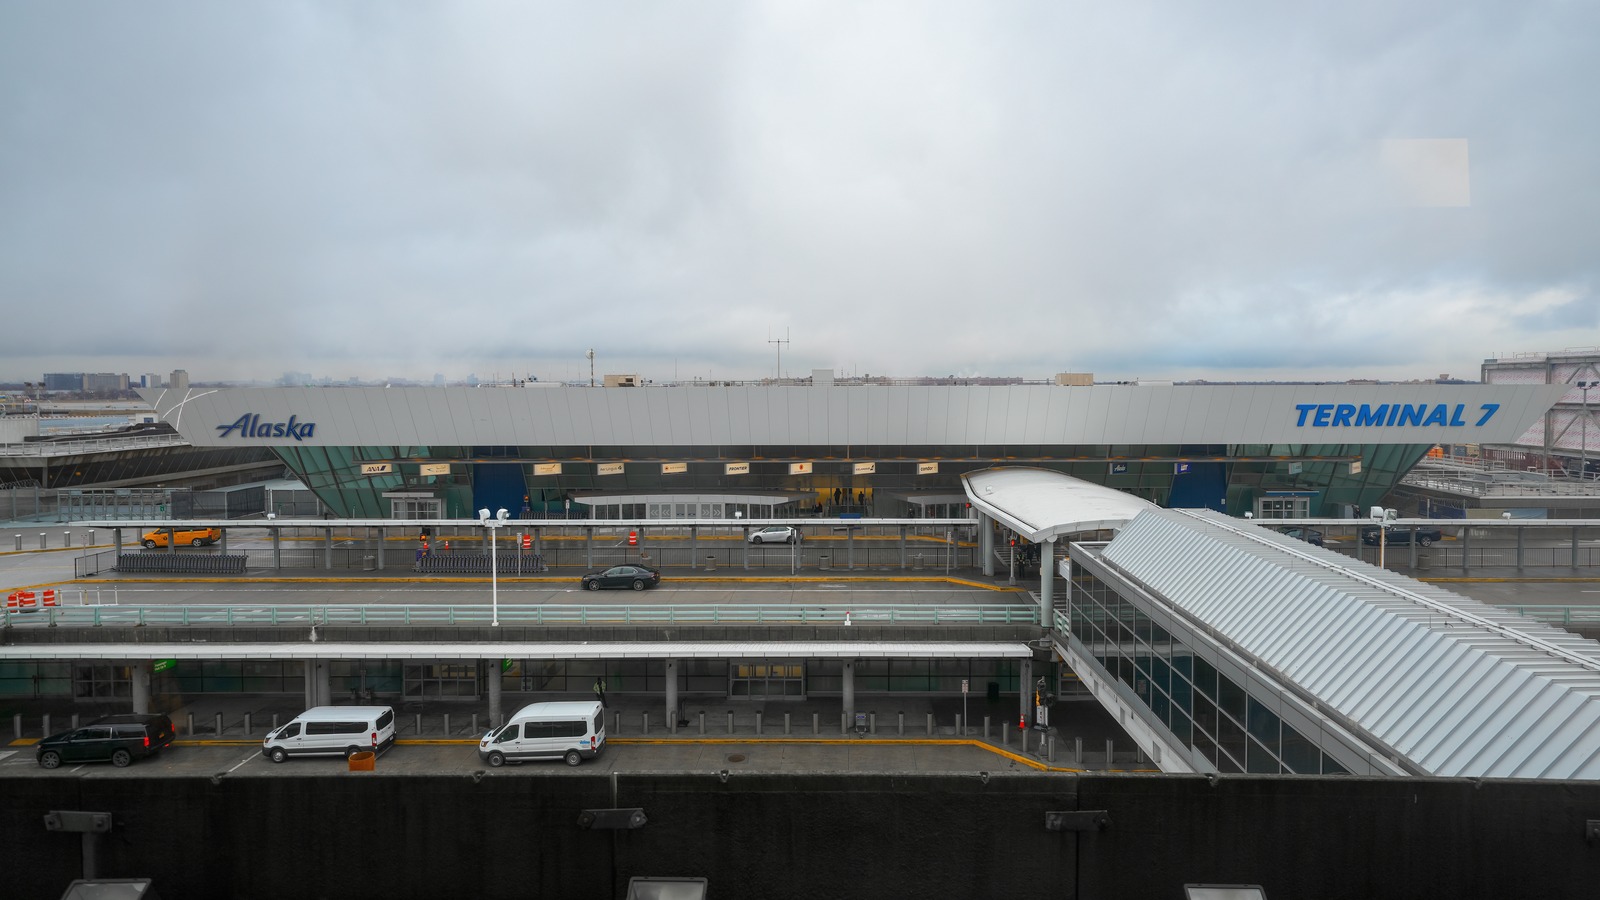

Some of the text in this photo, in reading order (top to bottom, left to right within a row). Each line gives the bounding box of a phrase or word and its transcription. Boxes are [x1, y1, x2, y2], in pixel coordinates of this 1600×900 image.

[215, 412, 316, 441] Alaska
[1295, 403, 1501, 427] TERMINAL 7
